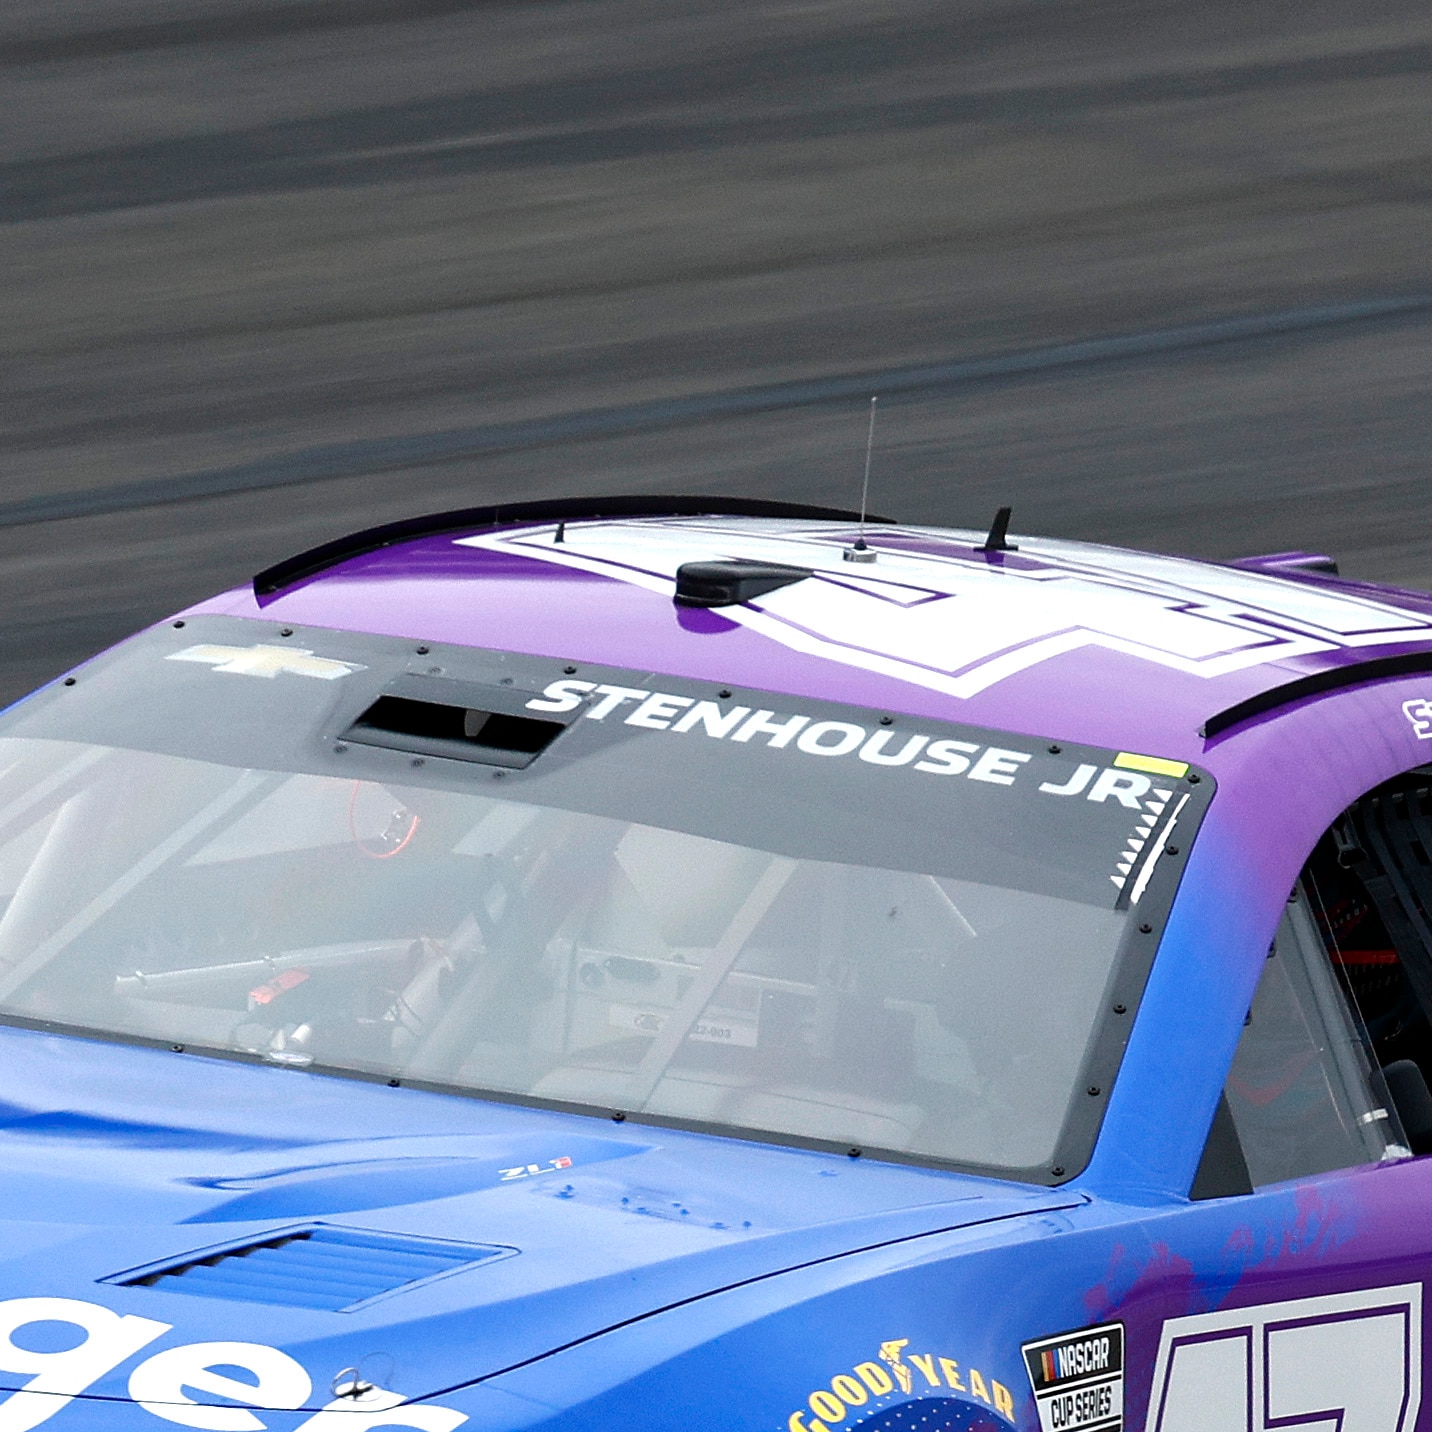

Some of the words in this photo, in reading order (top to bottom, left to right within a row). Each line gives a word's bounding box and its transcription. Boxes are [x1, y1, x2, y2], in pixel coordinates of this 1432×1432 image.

[525, 679, 1033, 786] STENHOUSE
[1037, 762, 1153, 810] JR
[1058, 1336, 1110, 1379] NASCAR
[1051, 1395, 1074, 1429] CUP
[1075, 1385, 1112, 1422] SERIES
